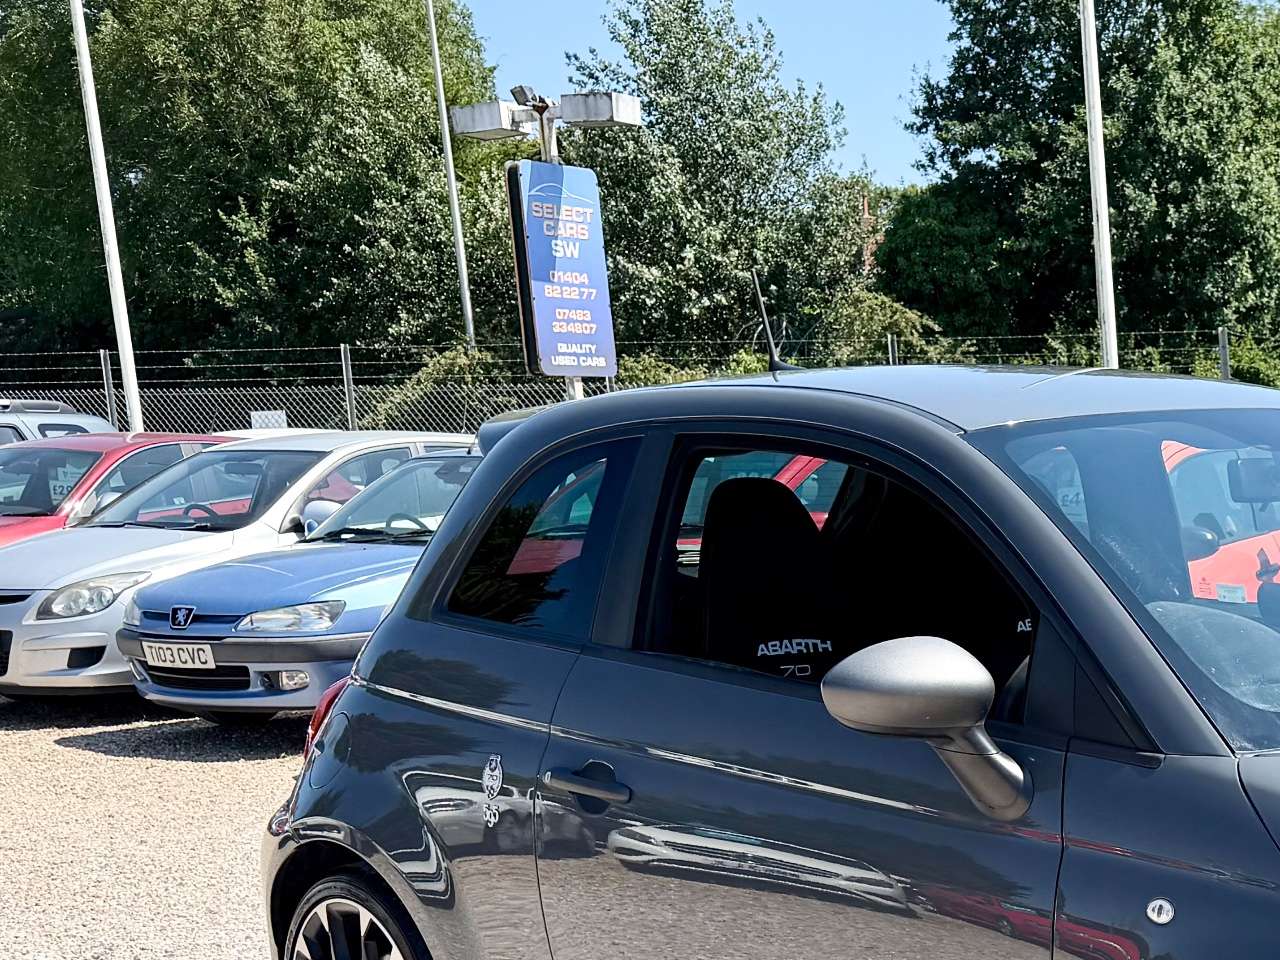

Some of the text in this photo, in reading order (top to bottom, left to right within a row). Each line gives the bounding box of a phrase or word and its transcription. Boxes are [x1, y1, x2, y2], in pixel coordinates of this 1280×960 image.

[531, 201, 593, 222] SELECT
[543, 220, 589, 240] CARS
[551, 239, 580, 258] SW
[549, 270, 589, 285] 01404
[557, 342, 597, 354] QUALITY
[551, 355, 607, 367] USED CARS
[146, 645, 208, 665] T103 CVC
[757, 638, 833, 657] ABARTH
[779, 664, 811, 678] 70
